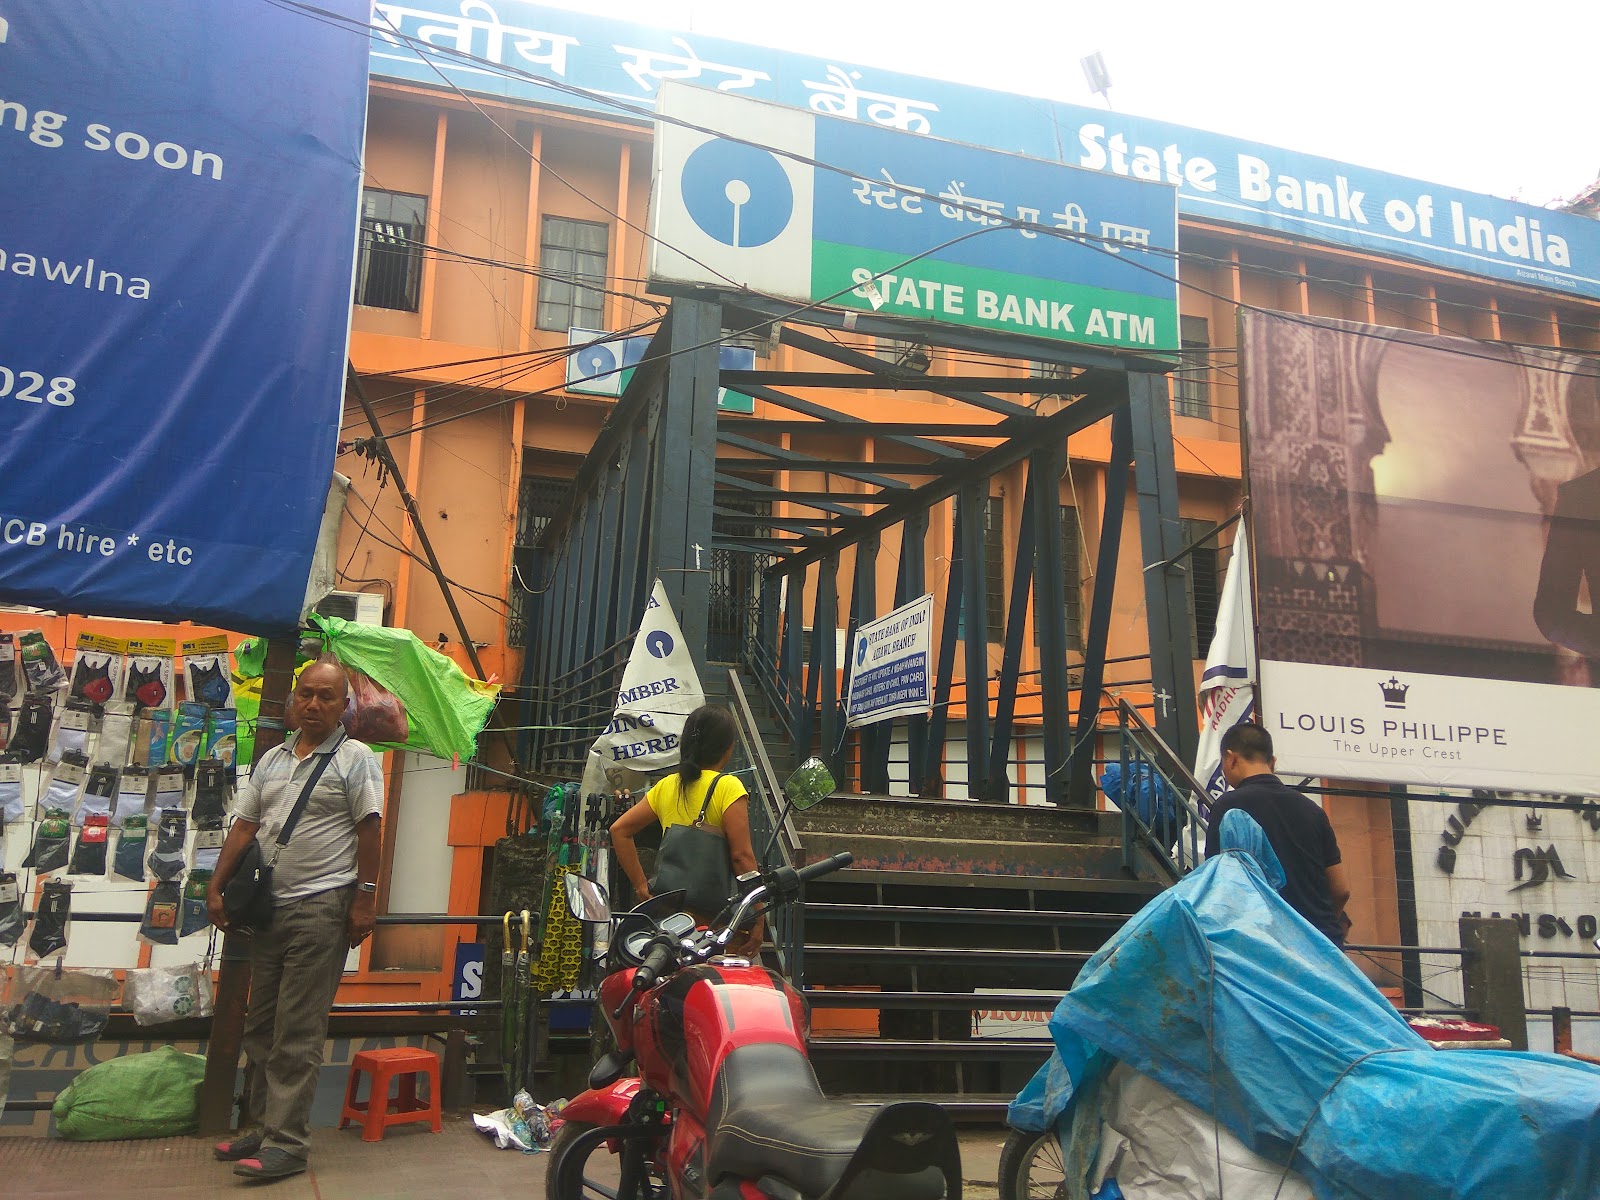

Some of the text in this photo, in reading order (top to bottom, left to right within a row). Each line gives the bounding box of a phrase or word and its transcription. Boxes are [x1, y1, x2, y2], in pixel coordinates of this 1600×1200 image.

[802, 64, 940, 135] बैंक
[84, 122, 224, 181] soon
[852, 168, 925, 214] स्टेट
[939, 180, 1005, 226] बैंक
[1079, 124, 1571, 268] State Bank of India
[1554, 276, 1577, 288] Branch
[851, 267, 1155, 345] STATE BANK ATM
[0, 516, 193, 566] CB hire etc
[885, 621, 900, 638] BANK
[614, 677, 680, 709] MBER
[910, 671, 924, 683] CARD
[1279, 712, 1508, 746] LOUIS PHILIPPE
[611, 733, 680, 762] HERE
[1333, 739, 1462, 760] The Upper Crest
